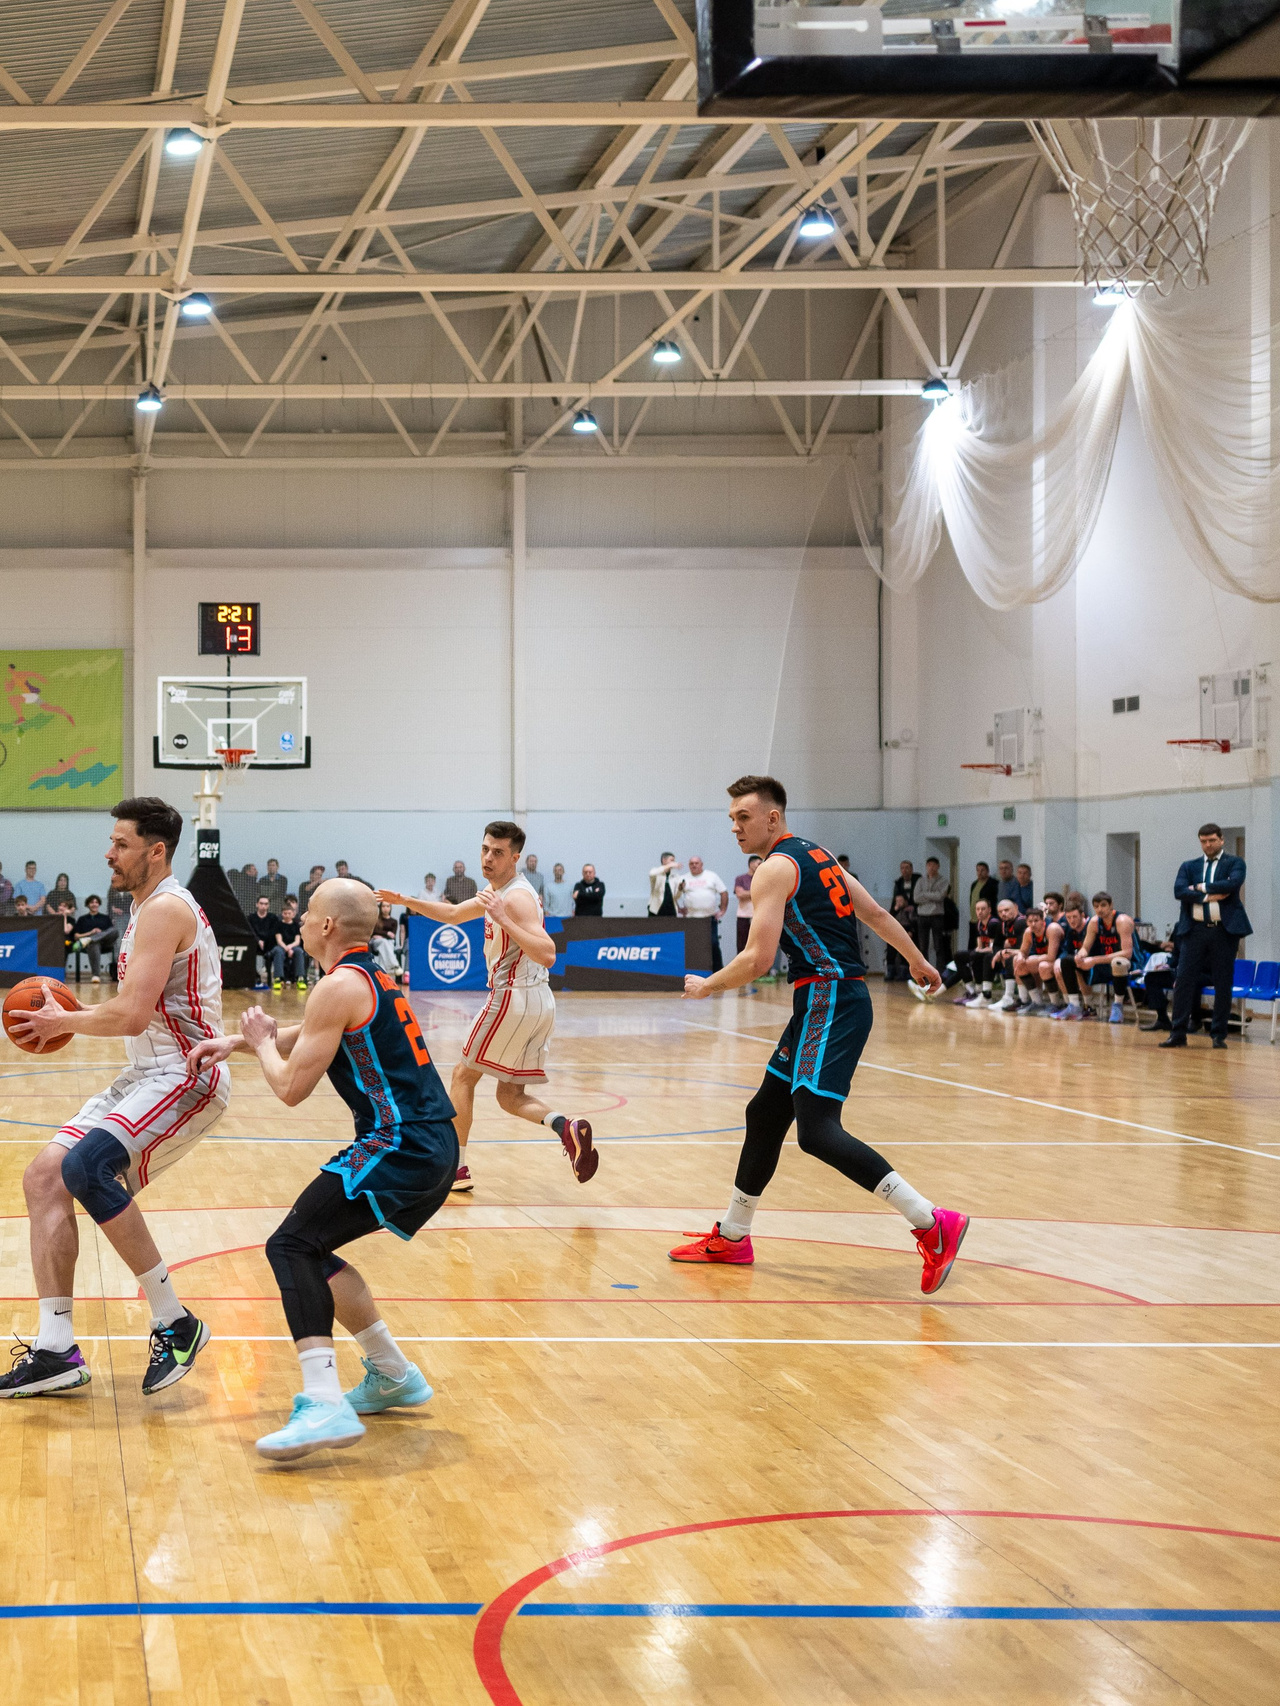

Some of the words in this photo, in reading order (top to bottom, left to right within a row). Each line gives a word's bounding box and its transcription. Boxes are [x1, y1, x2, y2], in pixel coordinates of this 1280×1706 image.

[217, 605, 252, 623] 2:21
[225, 625, 251, 652] 13
[199, 842, 219, 850] FON
[199, 850, 219, 859] BET
[597, 946, 662, 961] FONBET
